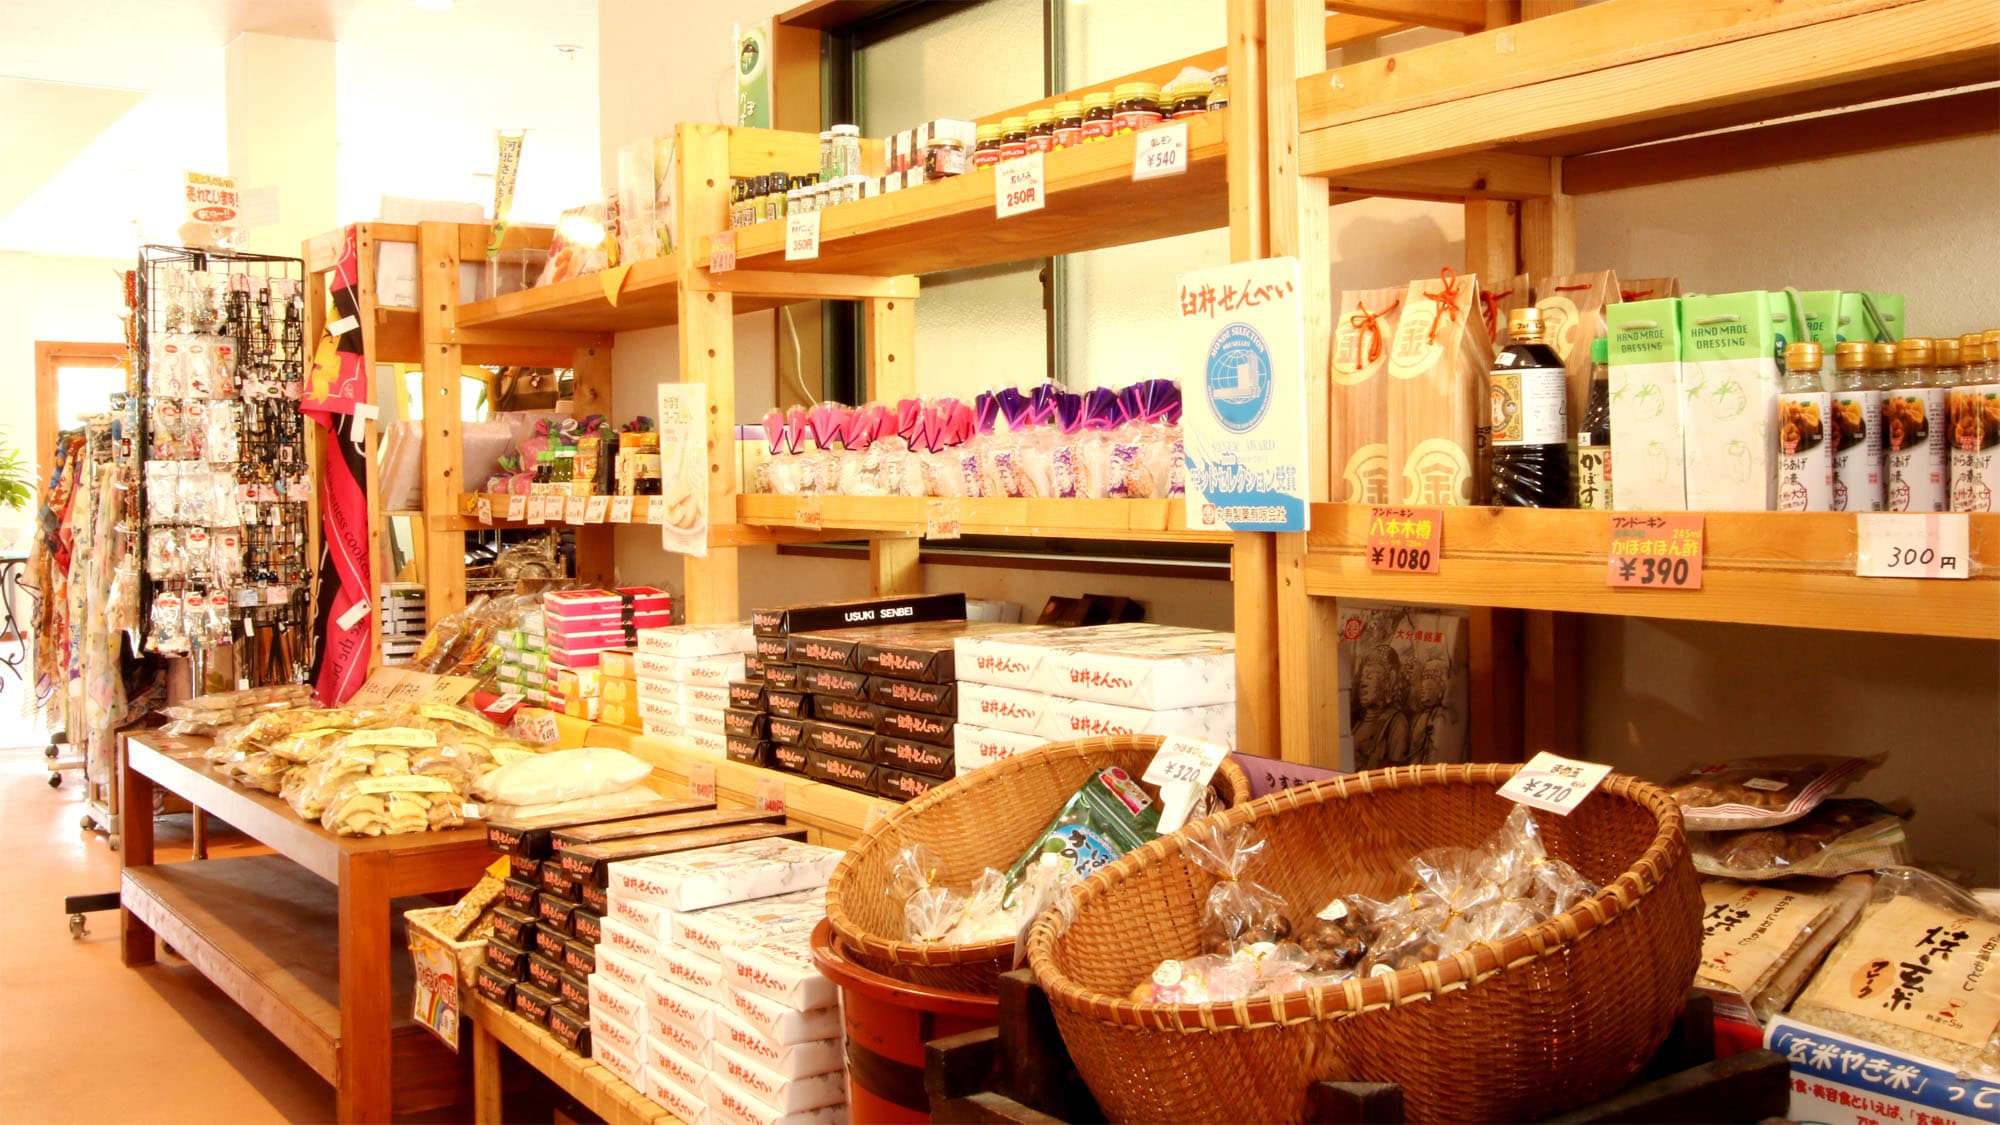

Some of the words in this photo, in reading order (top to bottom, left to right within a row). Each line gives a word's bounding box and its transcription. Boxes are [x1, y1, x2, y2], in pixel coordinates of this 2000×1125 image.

[1147, 150, 1176, 168] ¥540
[1007, 187, 1036, 207] 250円
[1180, 278, 1293, 319] 臼杵せんべい
[1617, 331, 1639, 342] HAND
[1641, 329, 1665, 341] MADE
[1691, 327, 1719, 338] HAND
[1721, 325, 1748, 335] MADE
[1621, 342, 1663, 353] DRESSING
[1696, 338, 1746, 350] DRESSING
[1372, 508, 1414, 518] フンドーキン
[1612, 516, 1667, 528] フンドーキン
[1370, 518, 1433, 540] 八本木樽
[1371, 546, 1431, 571] ¥1080
[1619, 557, 1689, 586] ¥390
[845, 610, 875, 622] USUKI
[880, 607, 914, 619] SENBEI
[977, 654, 1030, 674] 臼杵せんべい
[1070, 668, 1133, 688] 臼杵せんべい
[980, 699, 1036, 719] 臼杵せんべい
[1164, 760, 1201, 782] ¥320
[1522, 778, 1572, 803] ¥270
[1858, 961, 1890, 999] フレーク
